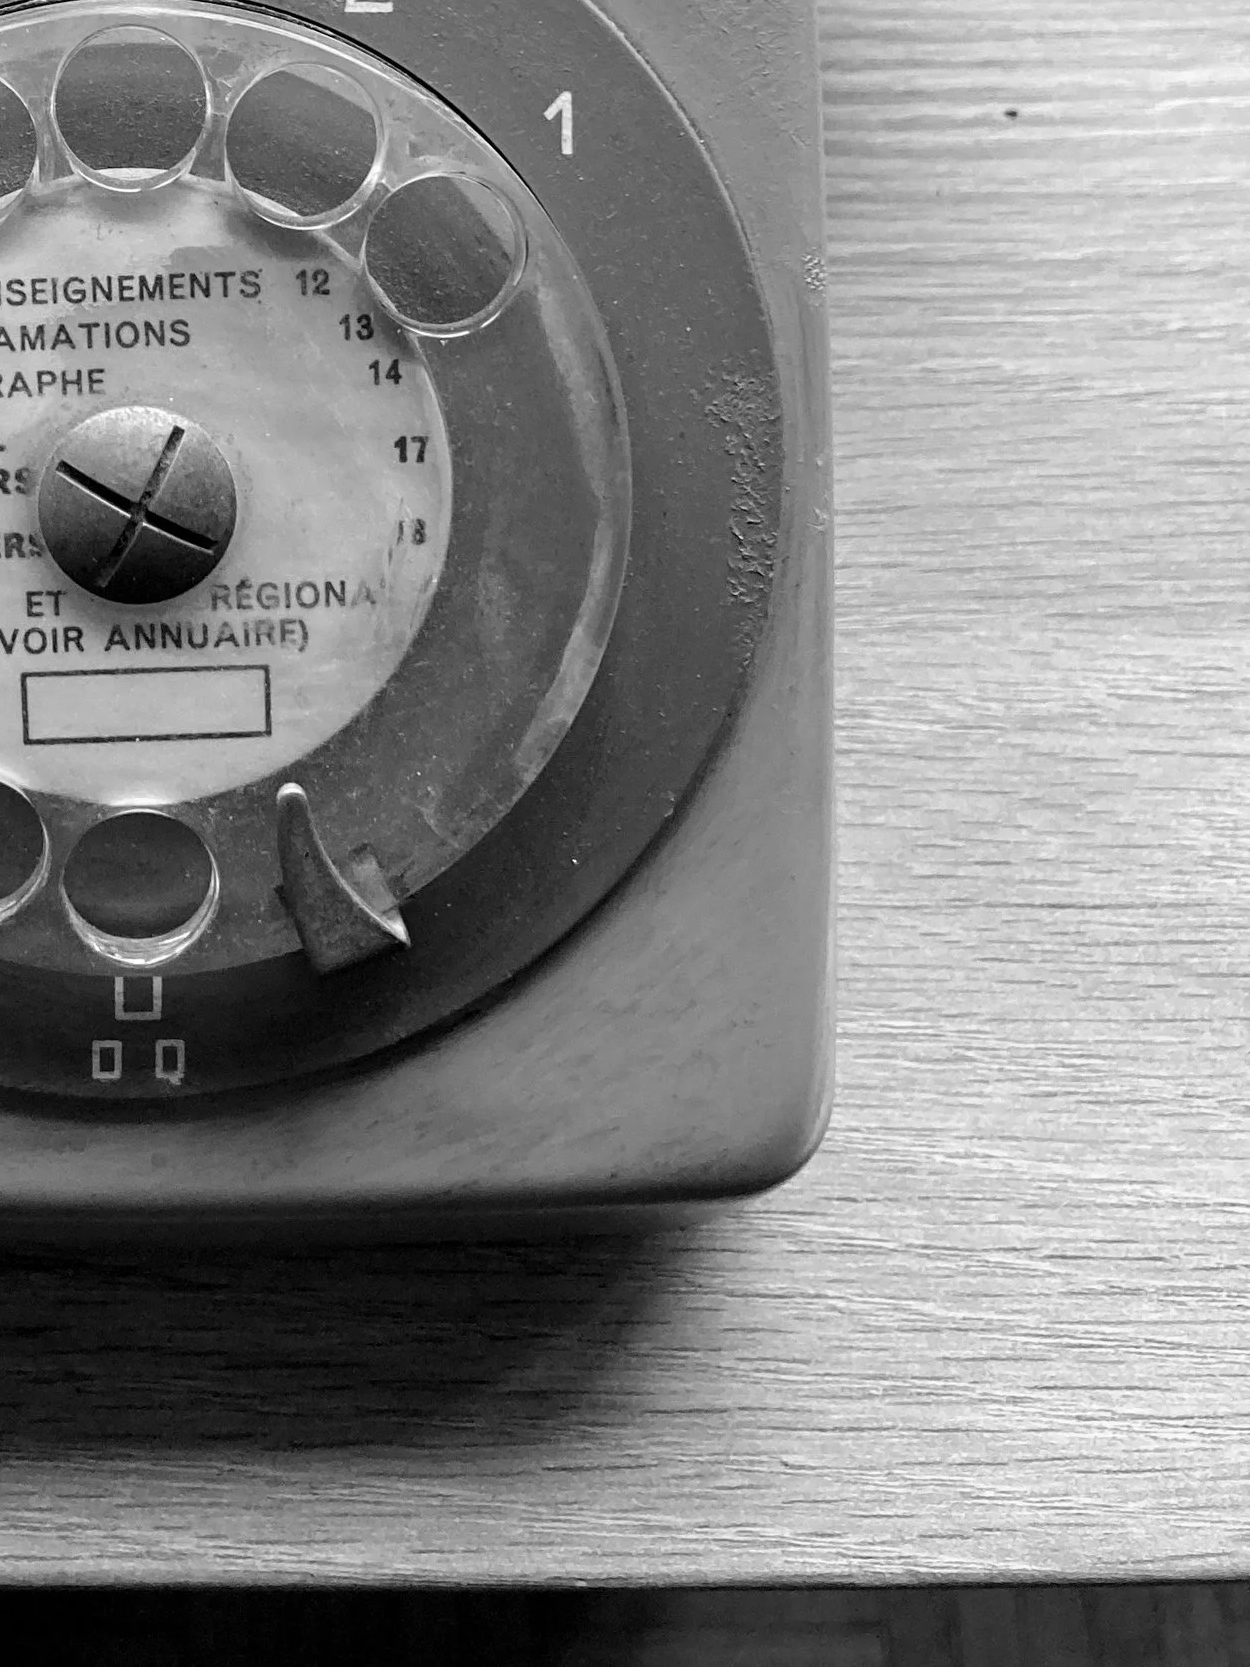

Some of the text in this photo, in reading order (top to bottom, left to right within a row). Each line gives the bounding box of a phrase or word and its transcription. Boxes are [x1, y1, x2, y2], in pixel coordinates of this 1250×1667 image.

[543, 90, 574, 156] 1
[296, 268, 331, 297] 12
[339, 314, 374, 342] 13
[368, 359, 403, 386] 14
[393, 435, 429, 464] 17
[25, 590, 67, 617] ET
[210, 577, 386, 612] RÉGIONA
[103, 617, 309, 653] ANNUAIRE)
